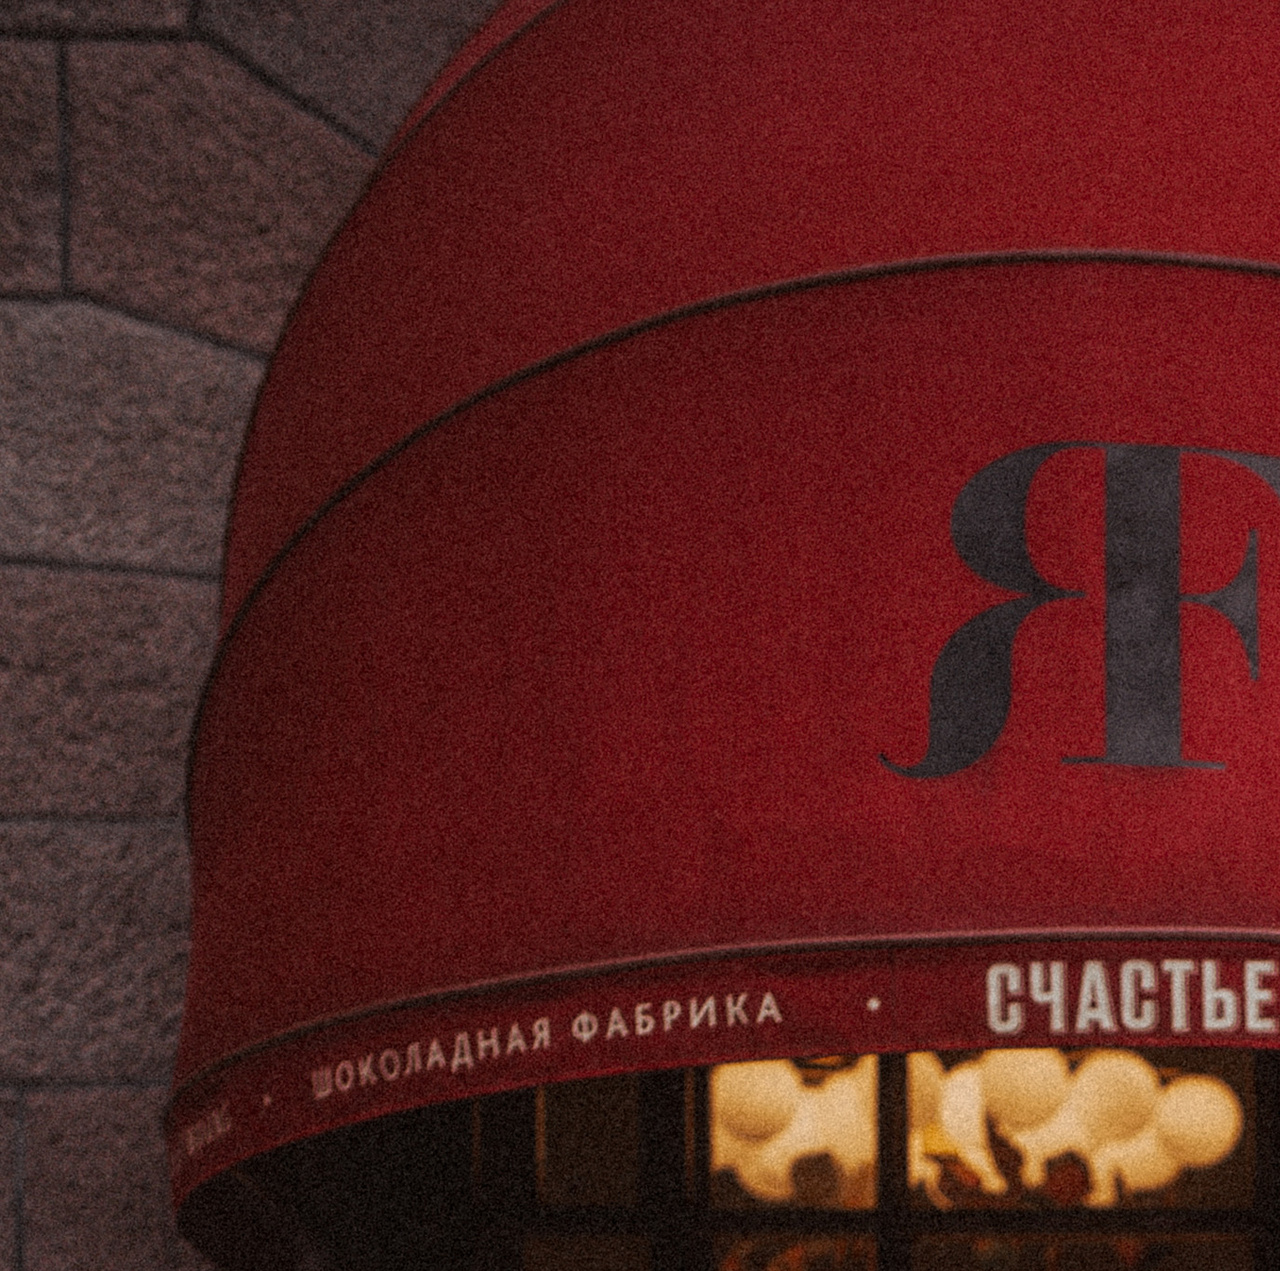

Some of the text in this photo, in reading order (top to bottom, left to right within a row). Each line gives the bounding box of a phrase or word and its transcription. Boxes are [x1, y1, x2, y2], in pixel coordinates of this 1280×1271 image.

[985, 958, 1280, 1035] СЧАСТЬЕ
[311, 992, 784, 1099] ШОКОЛАДНАЯ ФАБРИКА
